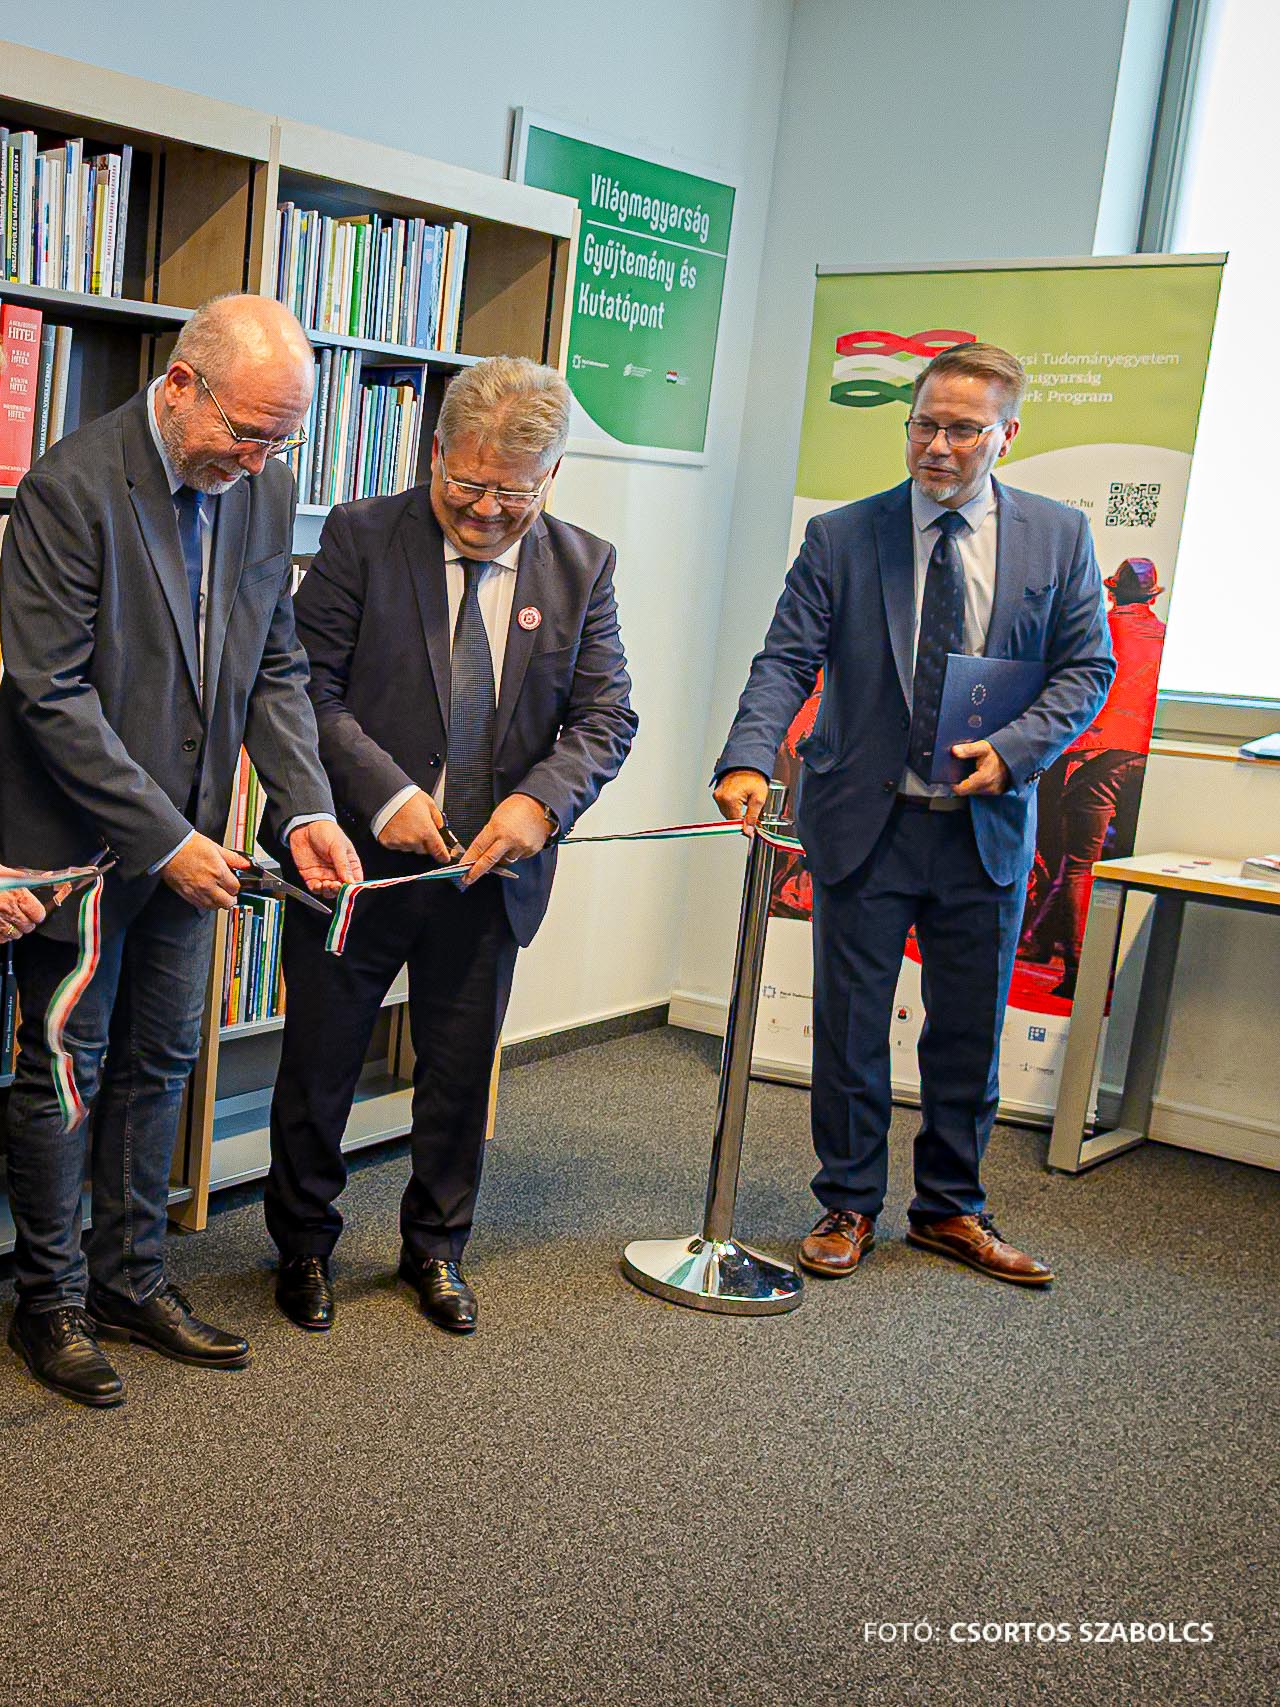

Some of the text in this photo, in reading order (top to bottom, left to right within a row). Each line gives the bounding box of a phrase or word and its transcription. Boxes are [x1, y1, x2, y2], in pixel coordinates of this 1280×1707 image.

[590, 173, 710, 244] Világmagyarság
[584, 233, 697, 292] Gyűjtemény és
[578, 282, 665, 332] Kutatópont
[8, 327, 37, 343] HITEL
[1042, 351, 1181, 368] Tudományegyetem
[1047, 390, 1114, 406] Program
